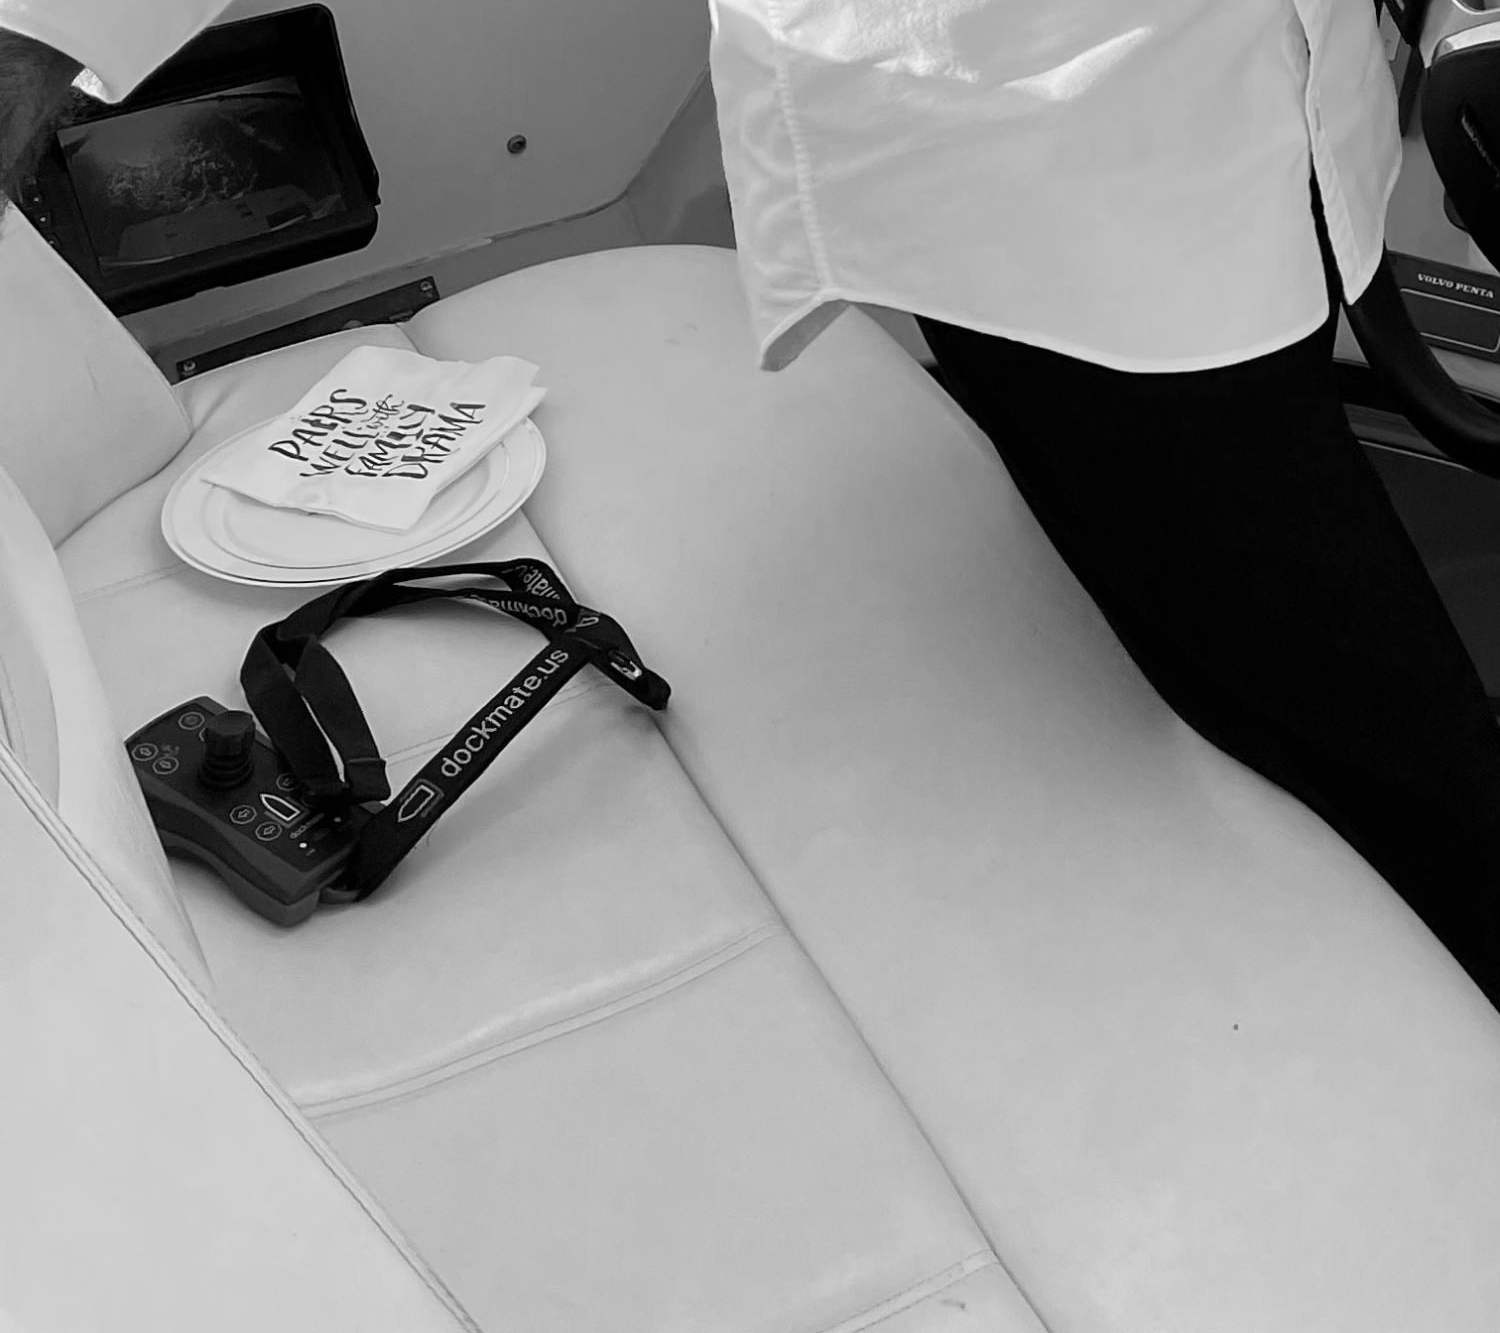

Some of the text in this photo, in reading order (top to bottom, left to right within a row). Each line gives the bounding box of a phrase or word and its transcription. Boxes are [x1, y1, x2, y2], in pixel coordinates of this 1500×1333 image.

[1418, 273, 1494, 299] VOLVO PENTA
[268, 389, 367, 461] PAIRS
[300, 394, 405, 477] WELL with
[344, 404, 435, 477] FAMILY
[382, 402, 486, 479] DRAMA
[440, 648, 570, 777] dockmate.us
